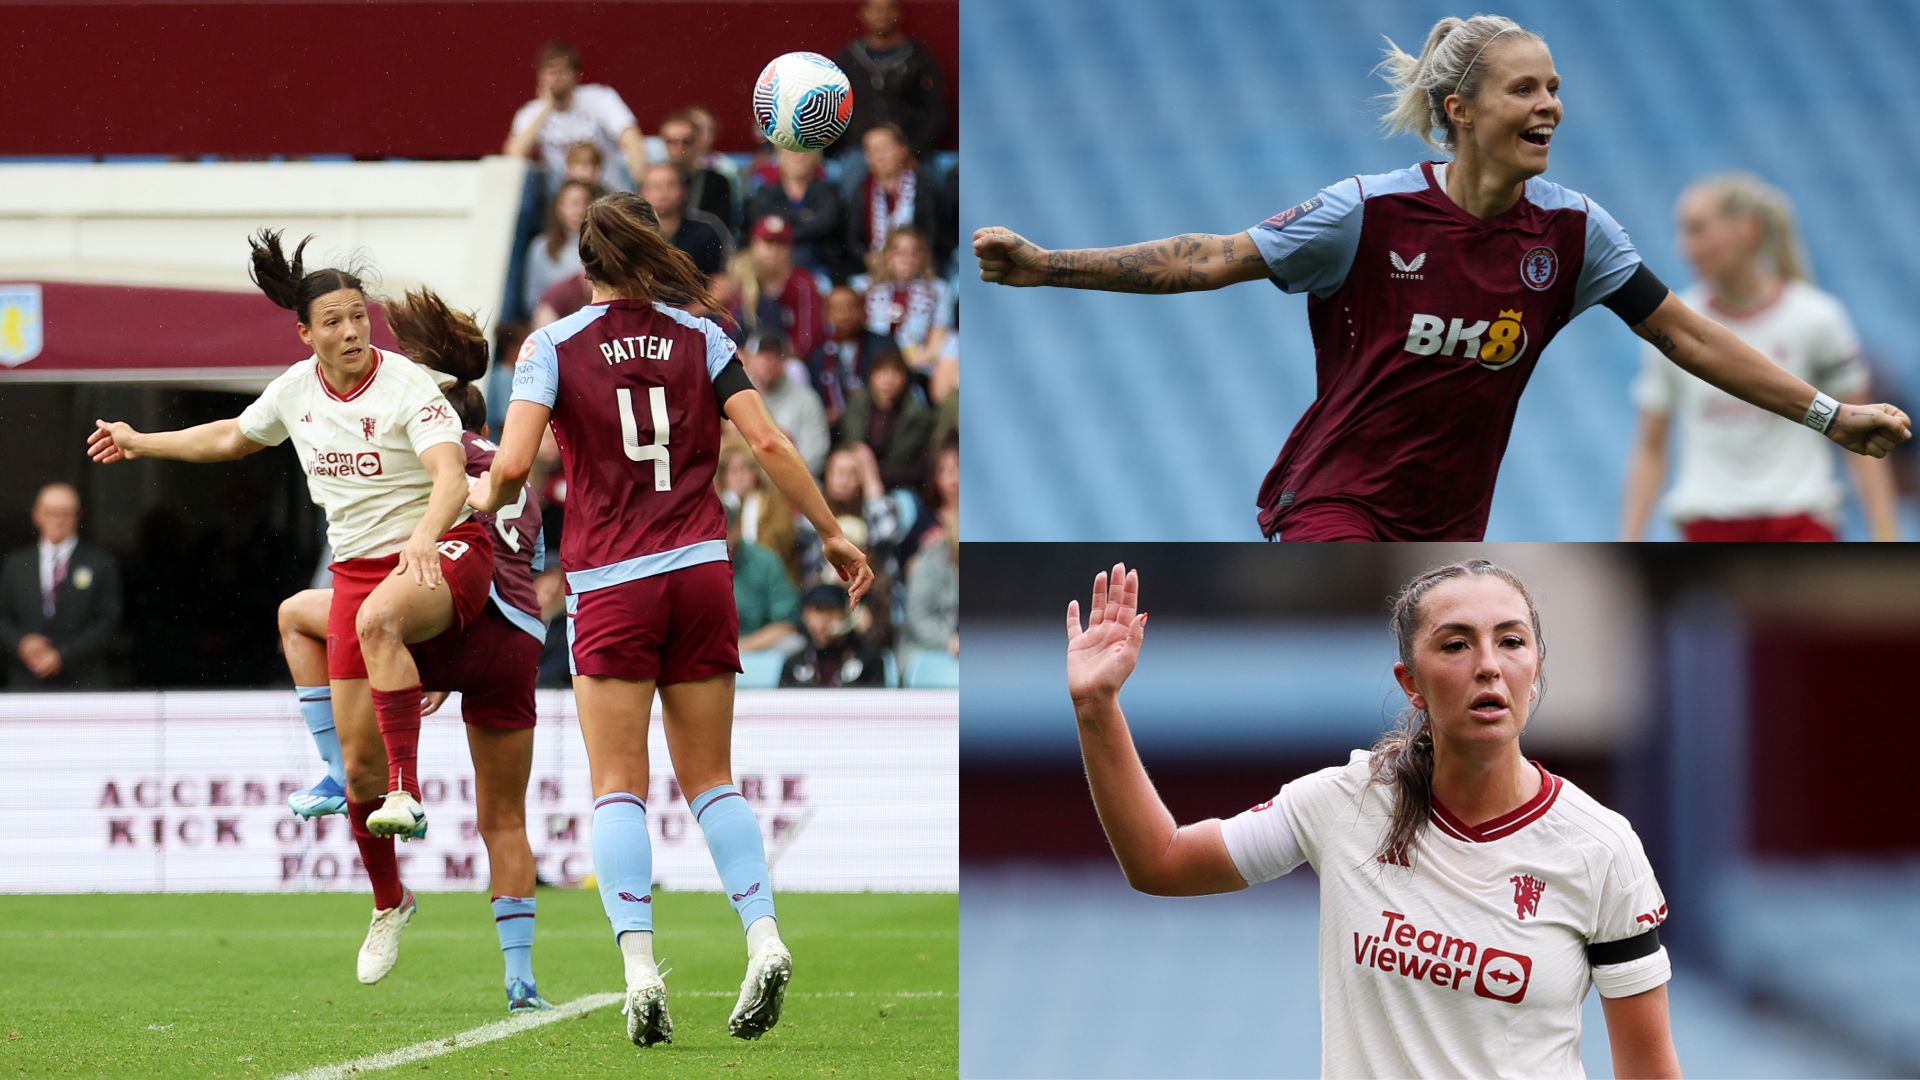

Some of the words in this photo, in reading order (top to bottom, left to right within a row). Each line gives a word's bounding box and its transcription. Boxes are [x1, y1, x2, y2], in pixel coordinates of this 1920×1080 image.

[1390, 272, 1424, 281] CASTORE
[599, 335, 674, 366] PATTEN
[1404, 312, 1523, 364] BK8
[616, 386, 672, 492] 4
[307, 458, 356, 478] Viewer
[313, 447, 353, 465] Team
[109, 818, 241, 846] KICK
[1381, 910, 1477, 966] Team
[1353, 931, 1472, 991] Viewer
